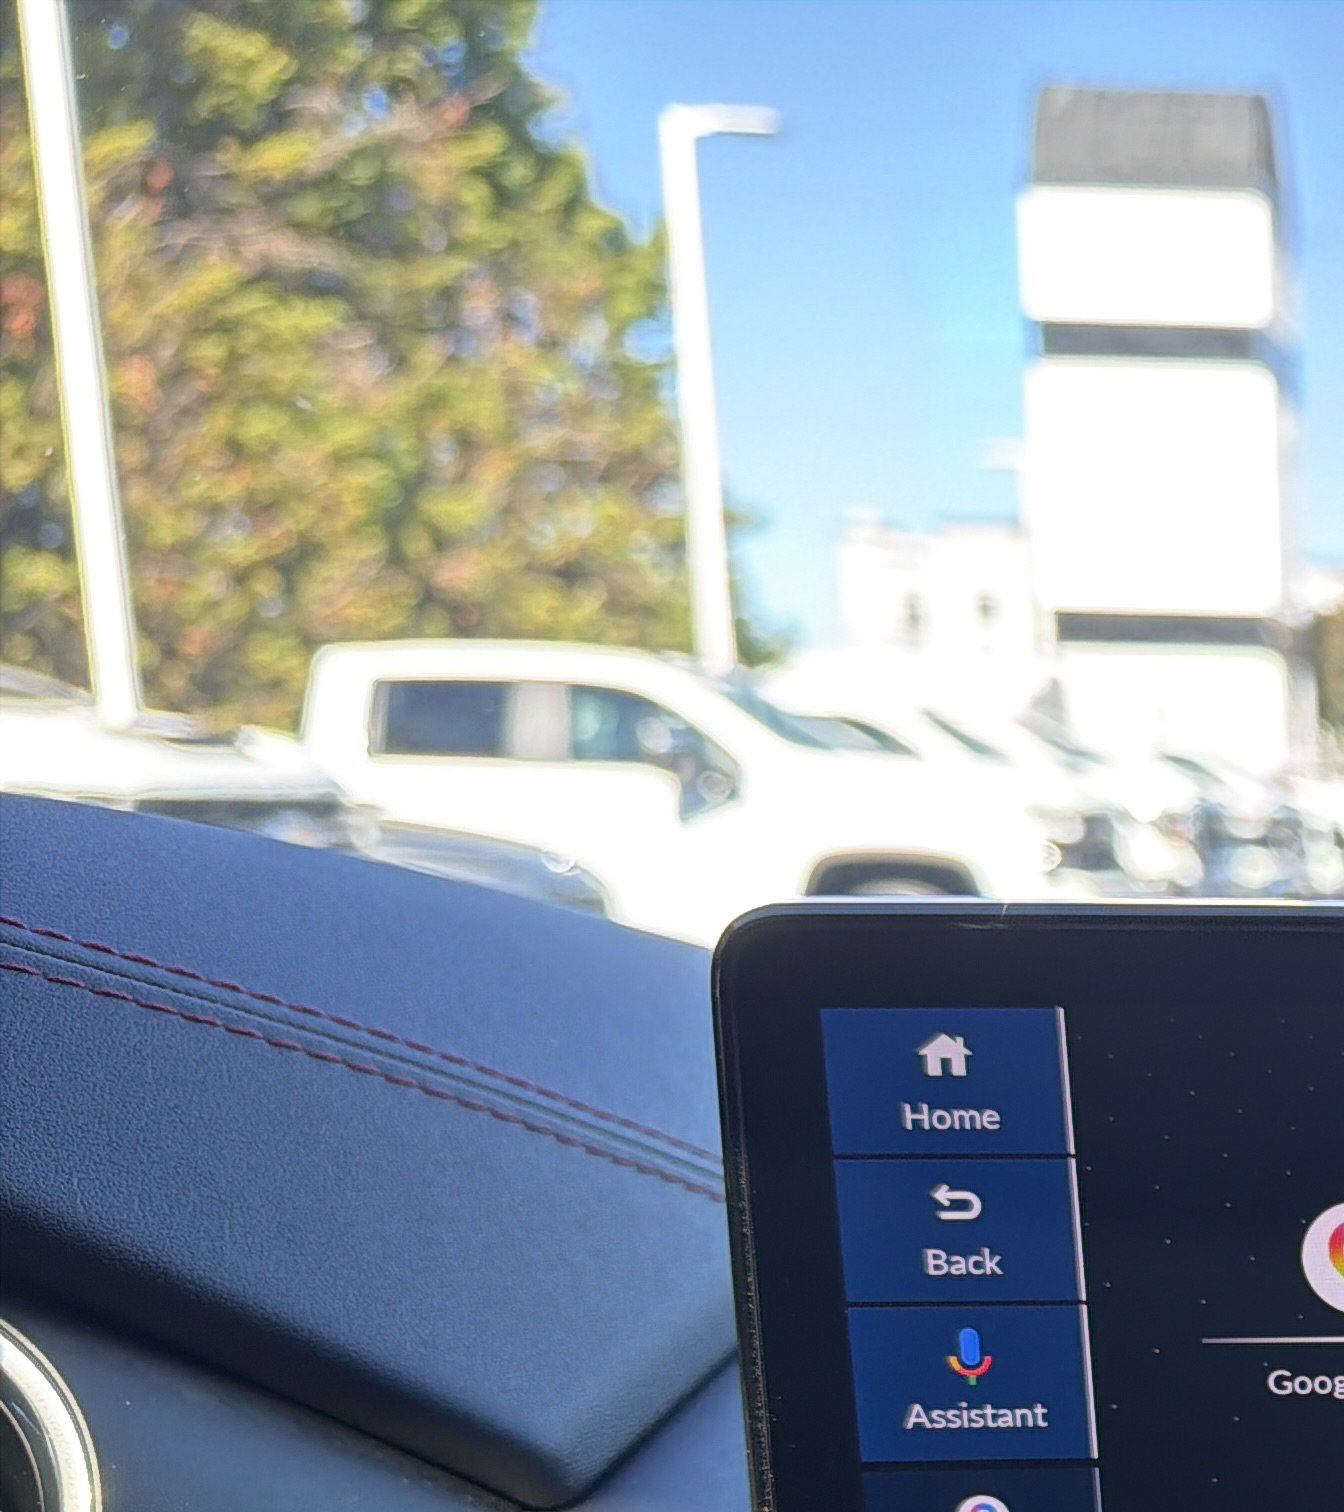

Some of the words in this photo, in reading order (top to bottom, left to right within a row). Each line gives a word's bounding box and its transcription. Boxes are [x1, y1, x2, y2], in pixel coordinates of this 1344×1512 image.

[904, 1104, 1000, 1130] Home
[925, 1248, 1003, 1275] Back
[906, 1402, 1048, 1429] Assistant
